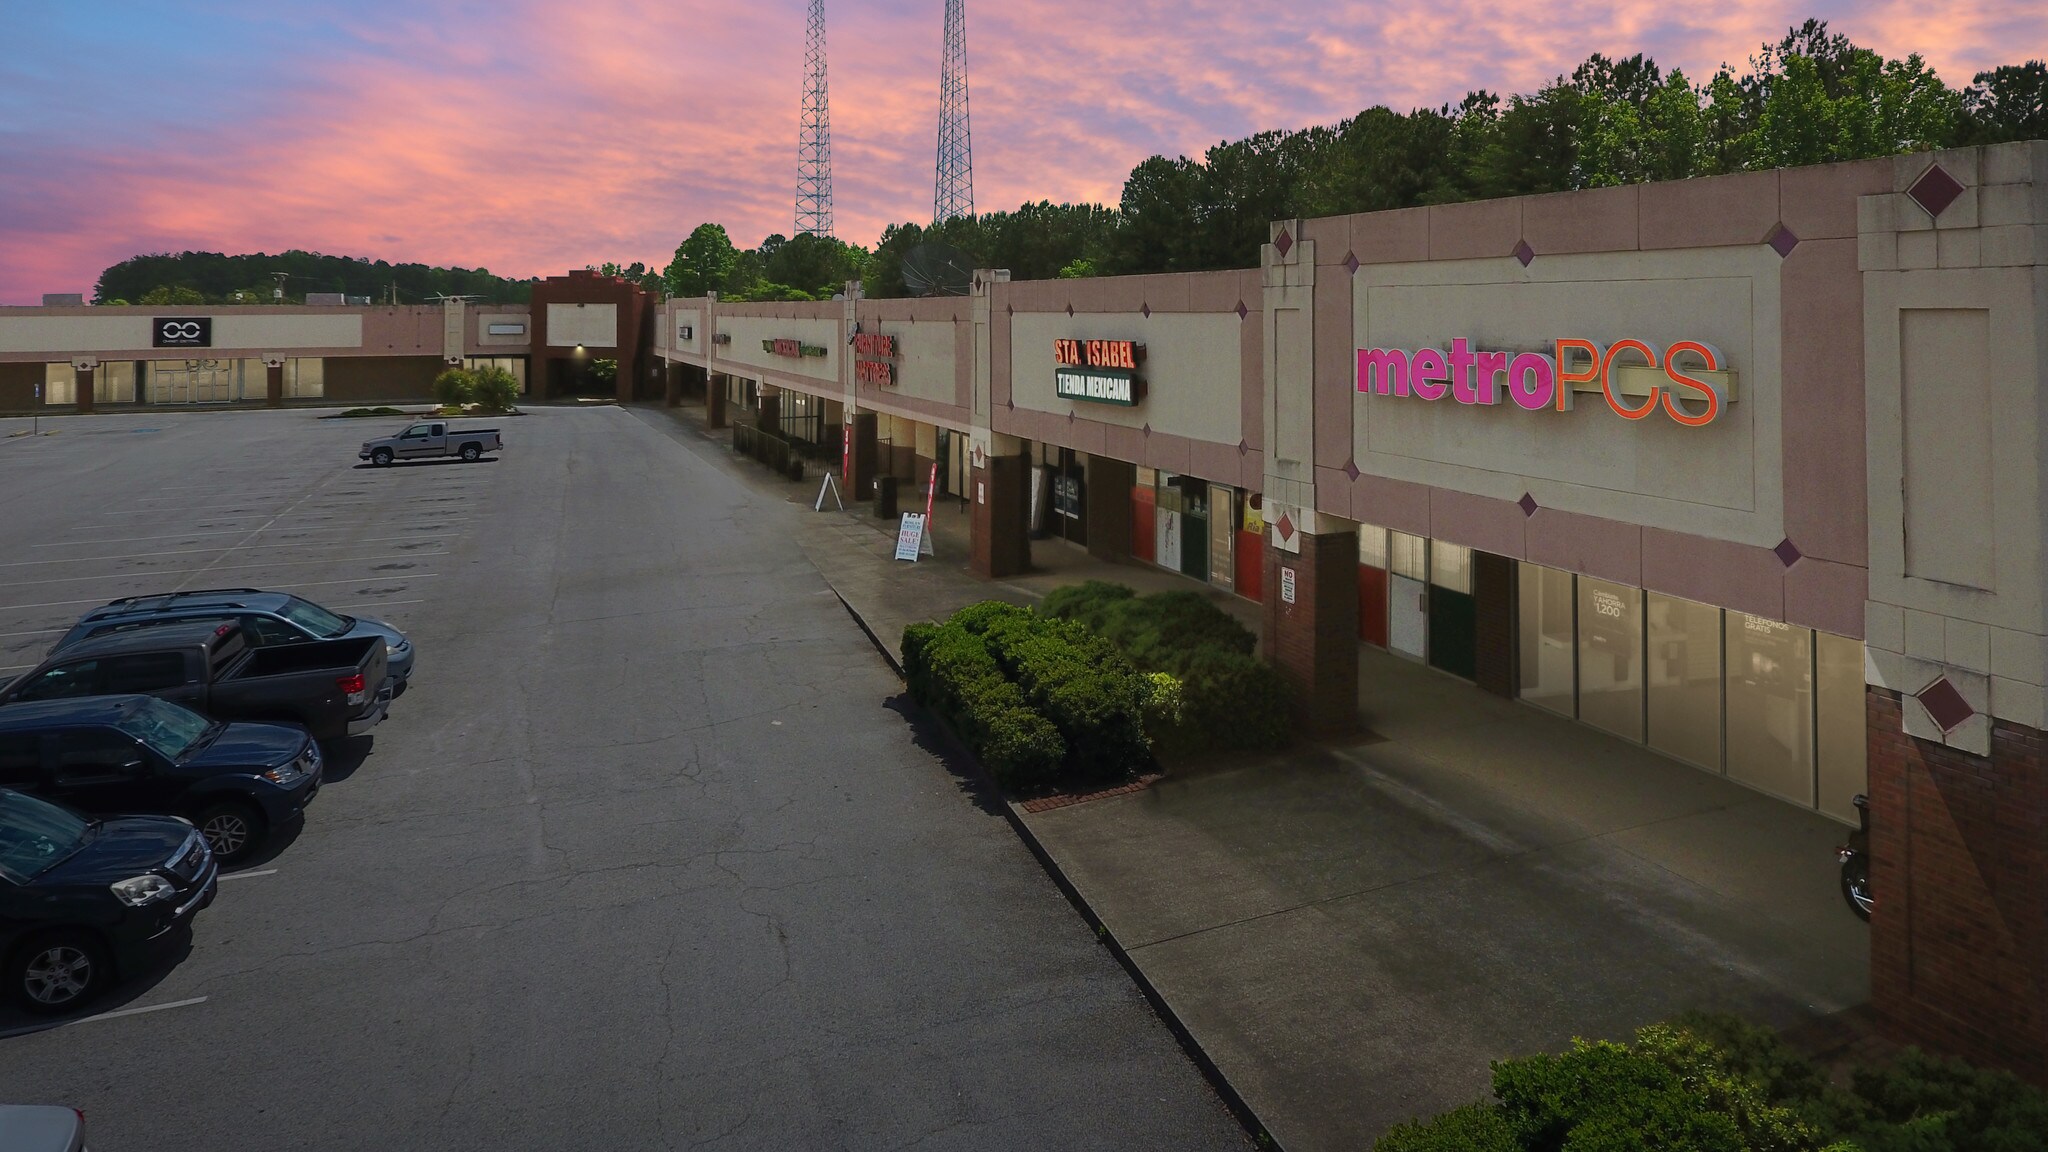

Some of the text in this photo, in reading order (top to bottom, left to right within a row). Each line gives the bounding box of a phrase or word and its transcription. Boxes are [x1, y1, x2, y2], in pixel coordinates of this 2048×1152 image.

[856, 333, 893, 357] FURNITURE
[1086, 340, 1136, 369] ISABEL
[1057, 373, 1131, 401] TIENDA MEXICANA
[1356, 336, 1719, 427] metroPCS
[901, 530, 920, 538] HUGE
[1284, 570, 1293, 579] NO
[1744, 621, 1771, 634] GRATIS
